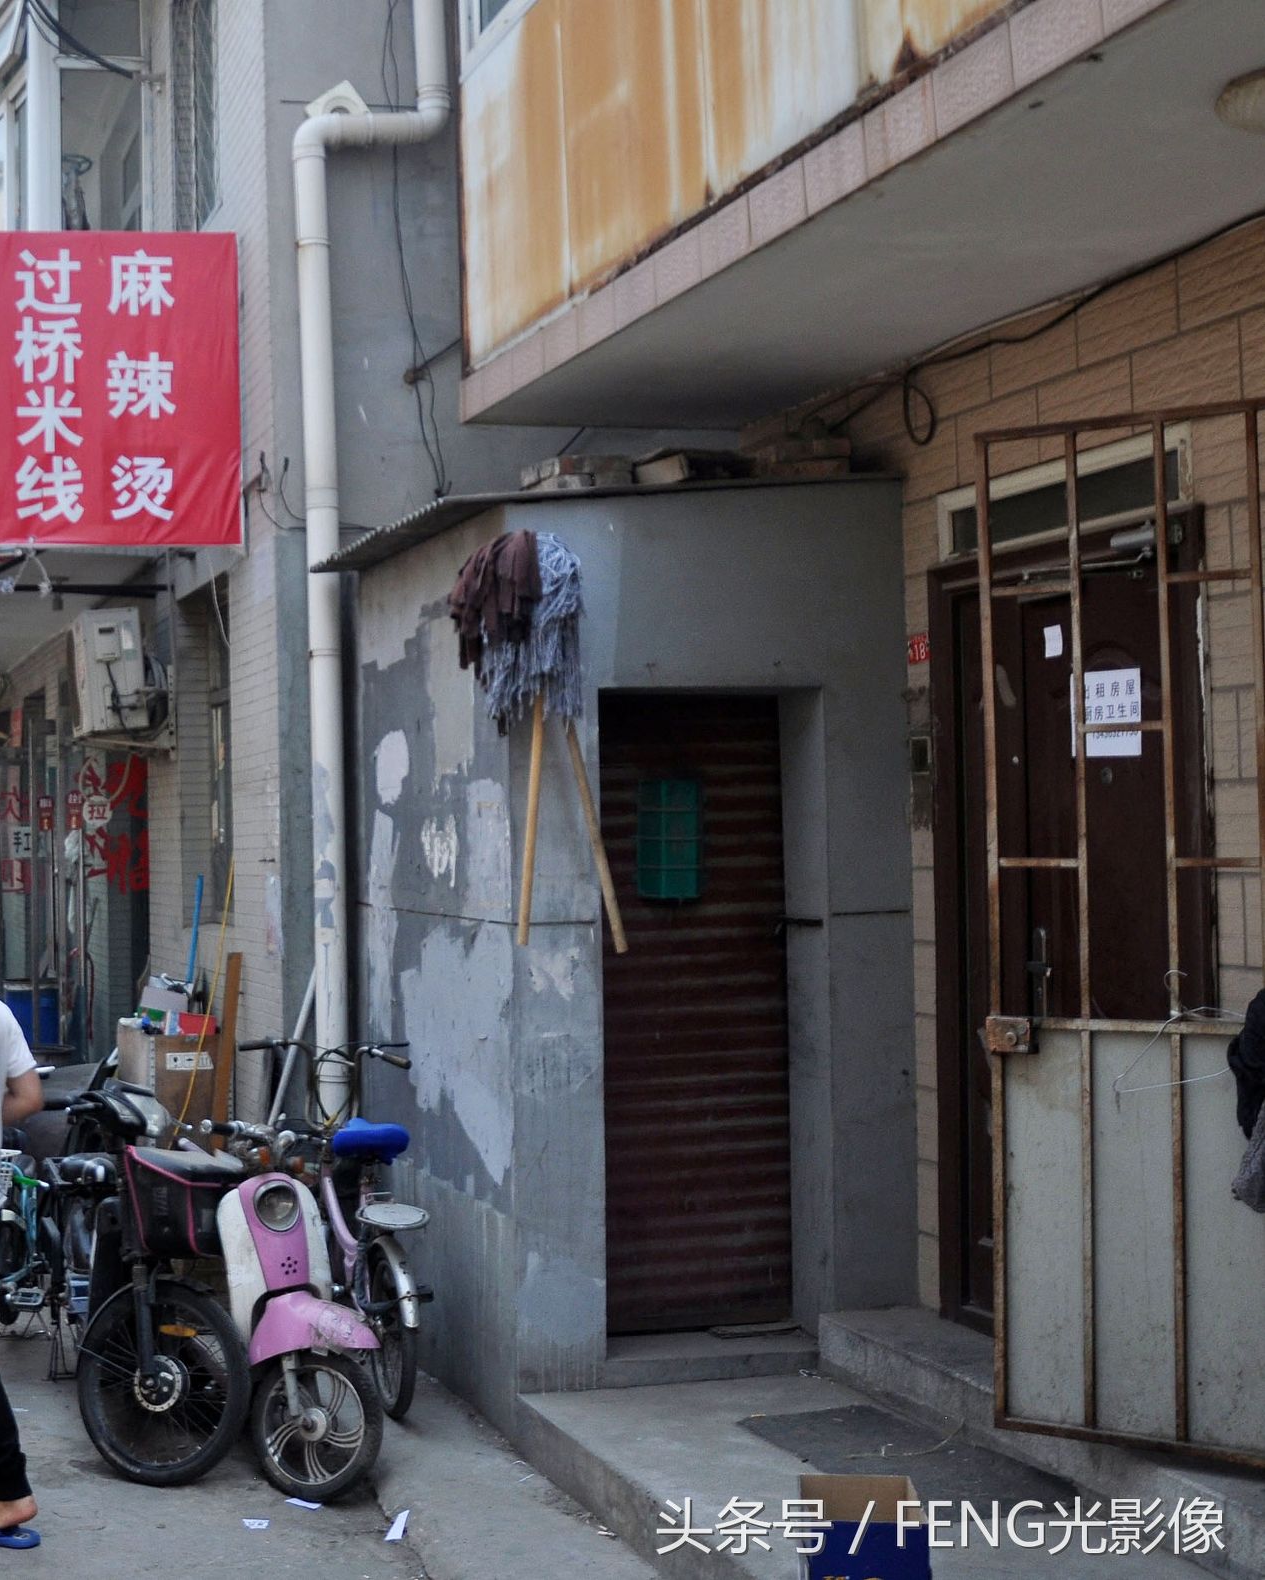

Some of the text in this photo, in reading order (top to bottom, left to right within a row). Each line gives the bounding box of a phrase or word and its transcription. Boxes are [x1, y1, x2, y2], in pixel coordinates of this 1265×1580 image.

[14, 248, 85, 524] 过桥米线
[106, 249, 177, 523] 麻辣烫
[88, 804, 108, 821] 拉
